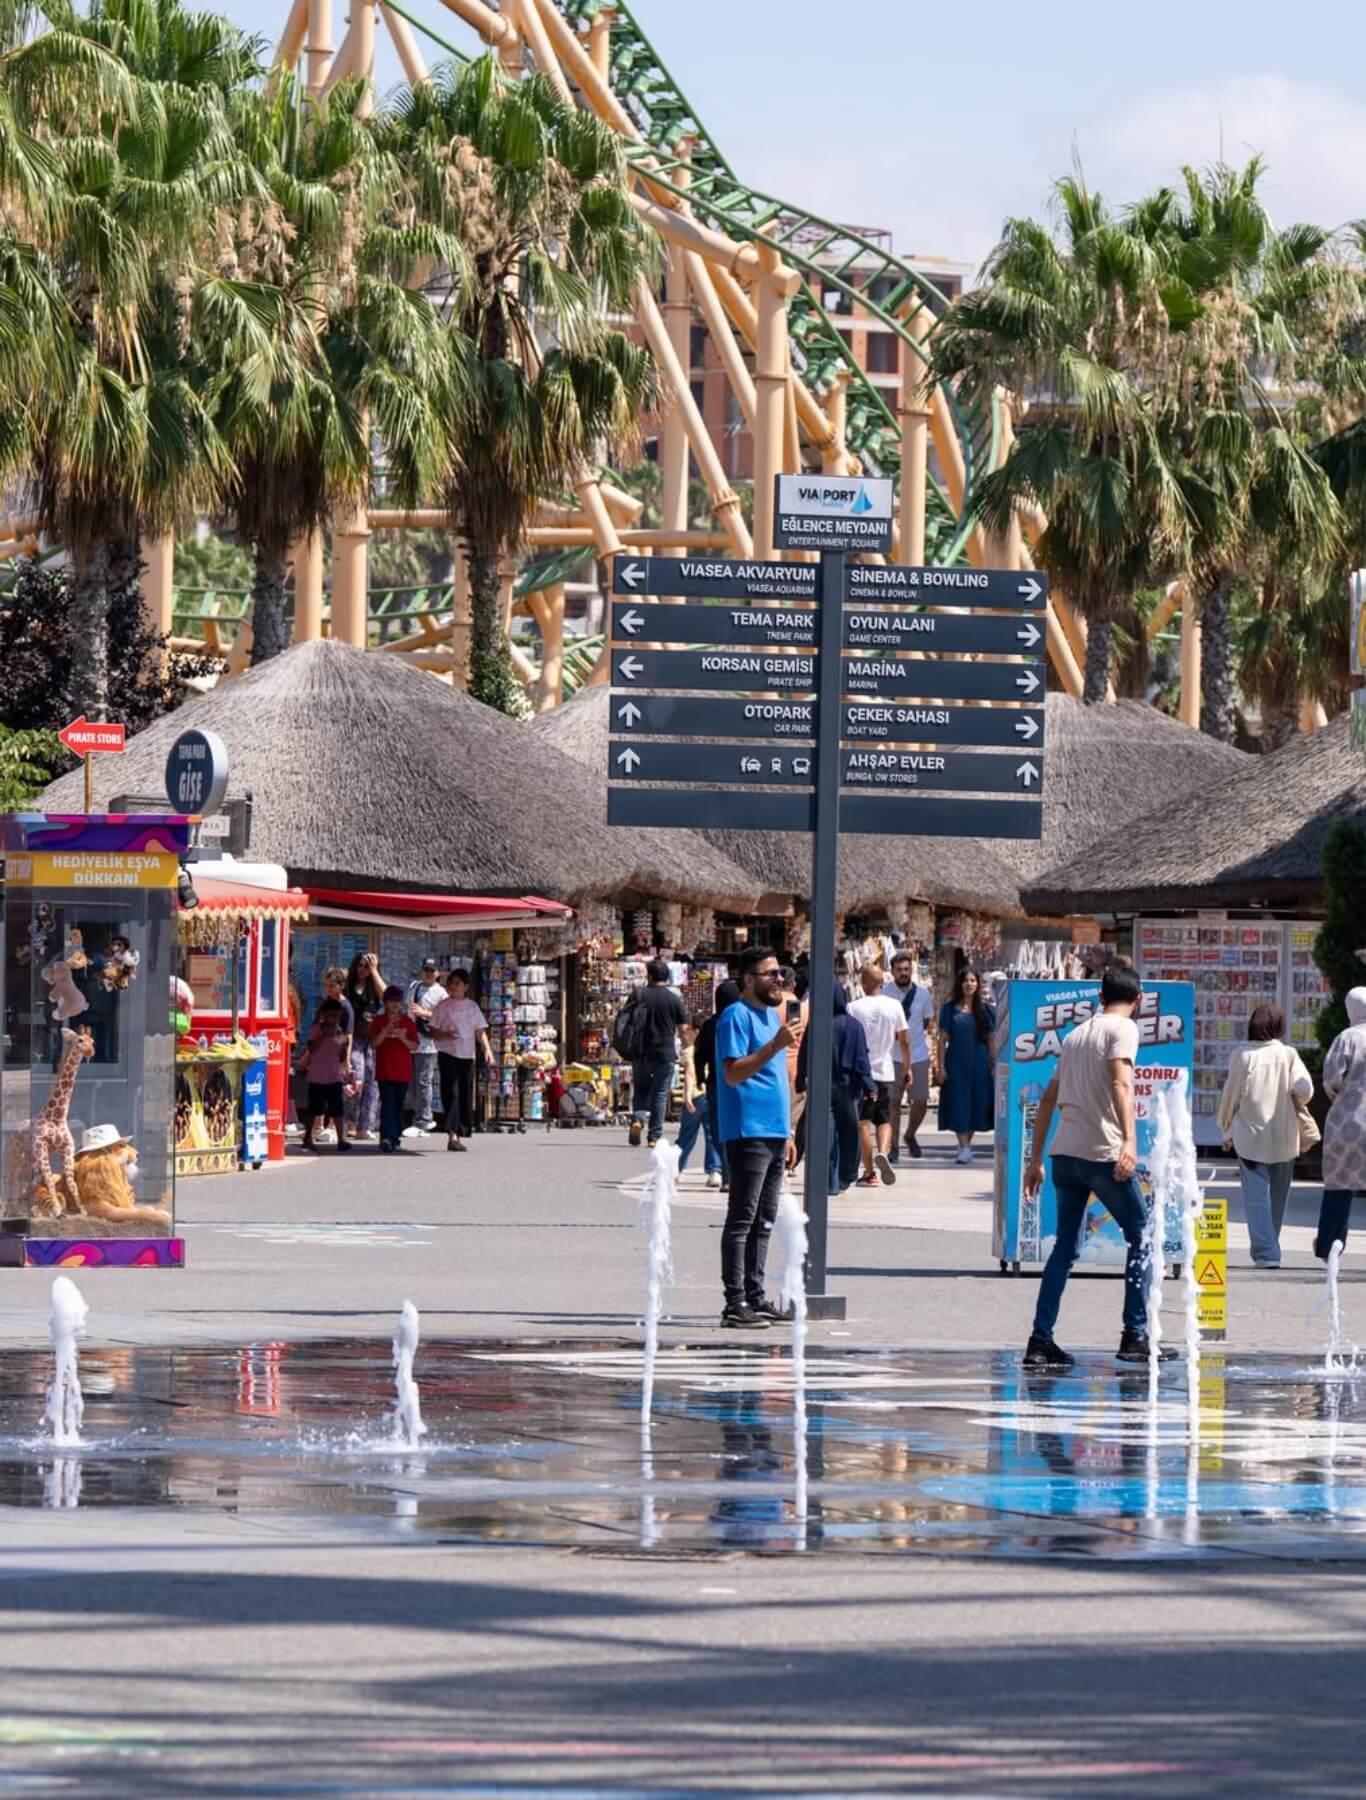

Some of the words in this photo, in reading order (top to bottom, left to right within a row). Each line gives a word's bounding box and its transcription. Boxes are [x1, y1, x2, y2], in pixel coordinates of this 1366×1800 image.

[781, 516, 833, 533] EĞLENCE
[835, 521, 888, 535] MEYDANI
[788, 536, 848, 548] ENTERTAINMENT
[850, 539, 880, 548] SQUARE
[680, 562, 733, 578] VIASEA
[736, 565, 816, 581] AKVARYUM
[850, 566, 906, 584] SİNEMA
[909, 572, 920, 585] &
[923, 572, 989, 588] BOWLING
[746, 583, 774, 593] VIASEA
[775, 584, 815, 594] AQUARIUM
[850, 587, 879, 597] CINEMA
[730, 612, 773, 626] TEMA
[776, 614, 814, 628] PARK
[850, 616, 888, 630] OYUN
[891, 618, 935, 632] ALANI
[766, 631, 792, 641] THEME
[794, 632, 813, 642] PARK
[850, 634, 871, 644] GAME
[872, 634, 901, 644] CENTER
[702, 657, 760, 672] KORSAN
[764, 657, 814, 674] GEMİSİ
[848, 660, 906, 677] MARİNA
[768, 677, 793, 687] PIRATE
[794, 678, 813, 688] SHIP
[848, 680, 878, 689] MARINA
[744, 704, 812, 720] OTOPARK
[848, 708, 894, 723] ÇEKEK
[896, 709, 950, 724] SAHASI
[774, 724, 790, 734] CAR
[792, 724, 812, 734] PARK
[847, 726, 867, 735] BOAT
[868, 726, 888, 736] YARD
[68, 732, 96, 743] PIRATE
[96, 733, 122, 744] STORE
[848, 754, 898, 769] AHŞAP
[900, 756, 945, 770] EVLER
[889, 773, 918, 784] STORES
[52, 852, 125, 868] HEDİYELİK
[128, 856, 161, 872] EŞYA
[74, 870, 139, 886] DÜKKANI
[1036, 992, 1159, 1030] EFSE
